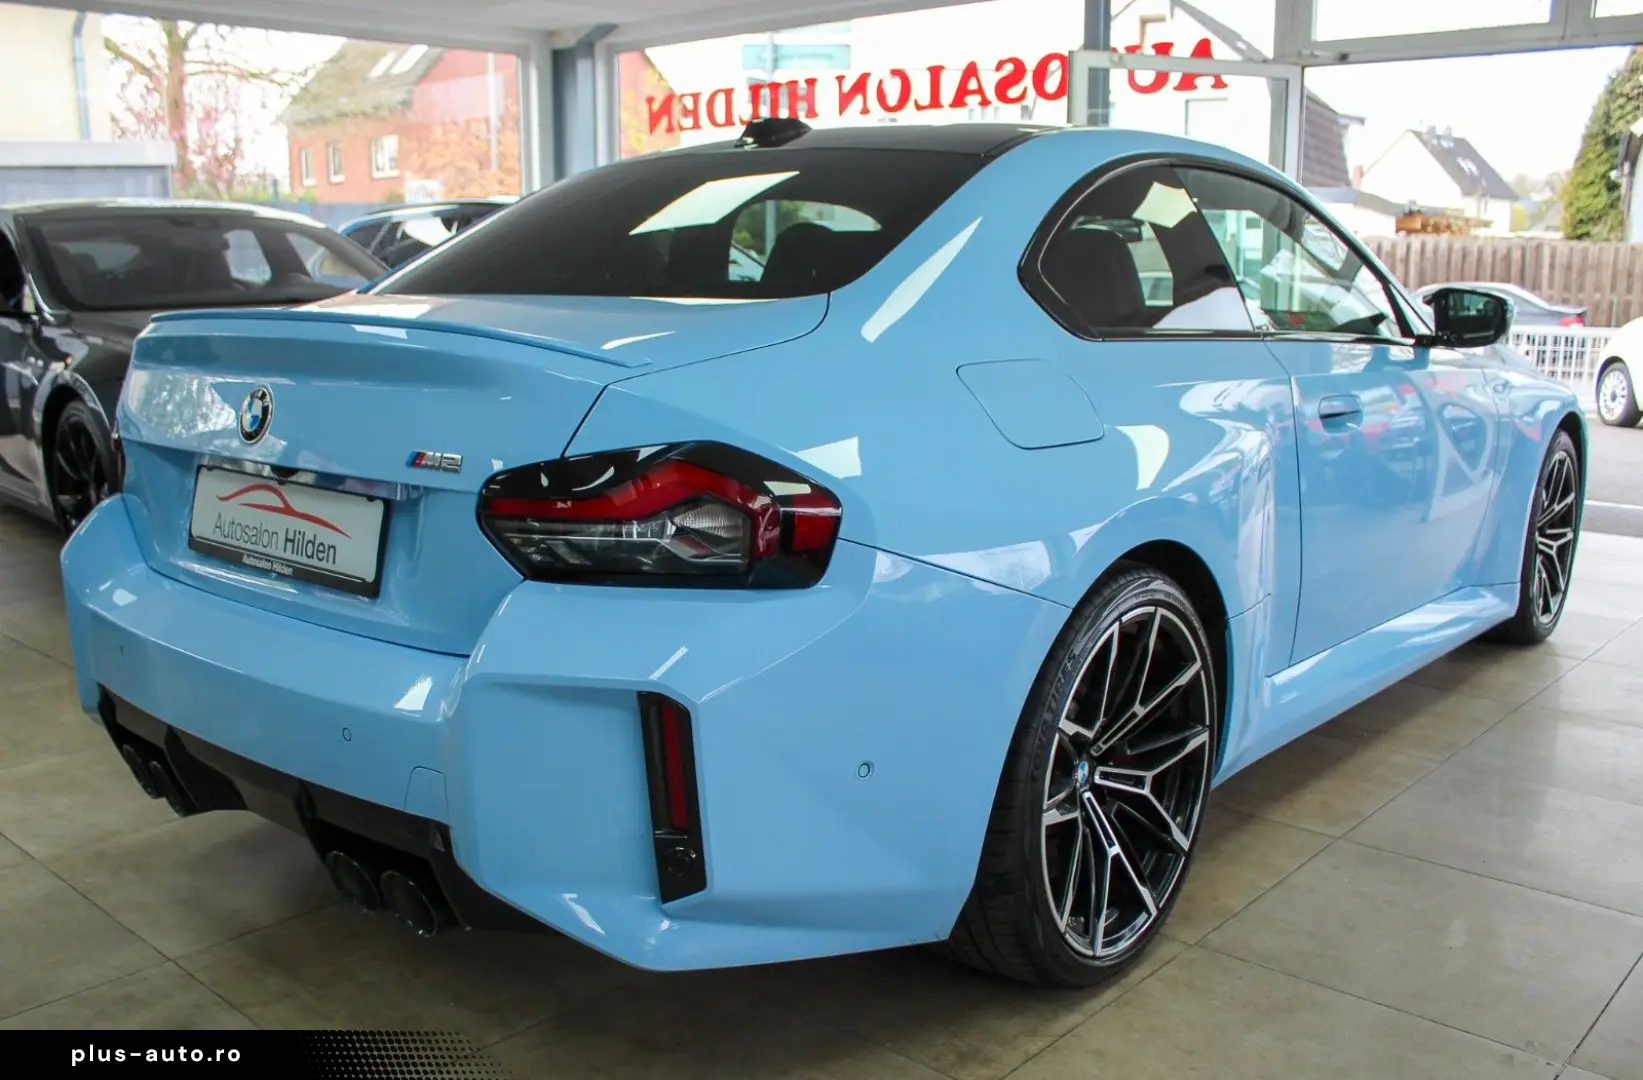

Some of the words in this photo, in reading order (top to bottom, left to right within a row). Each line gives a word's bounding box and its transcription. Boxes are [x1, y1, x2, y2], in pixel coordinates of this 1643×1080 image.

[213, 512, 279, 551] Autosalon
[283, 527, 337, 564] Hilden
[242, 553, 272, 570] Autosalon
[272, 561, 294, 576] Hilden
